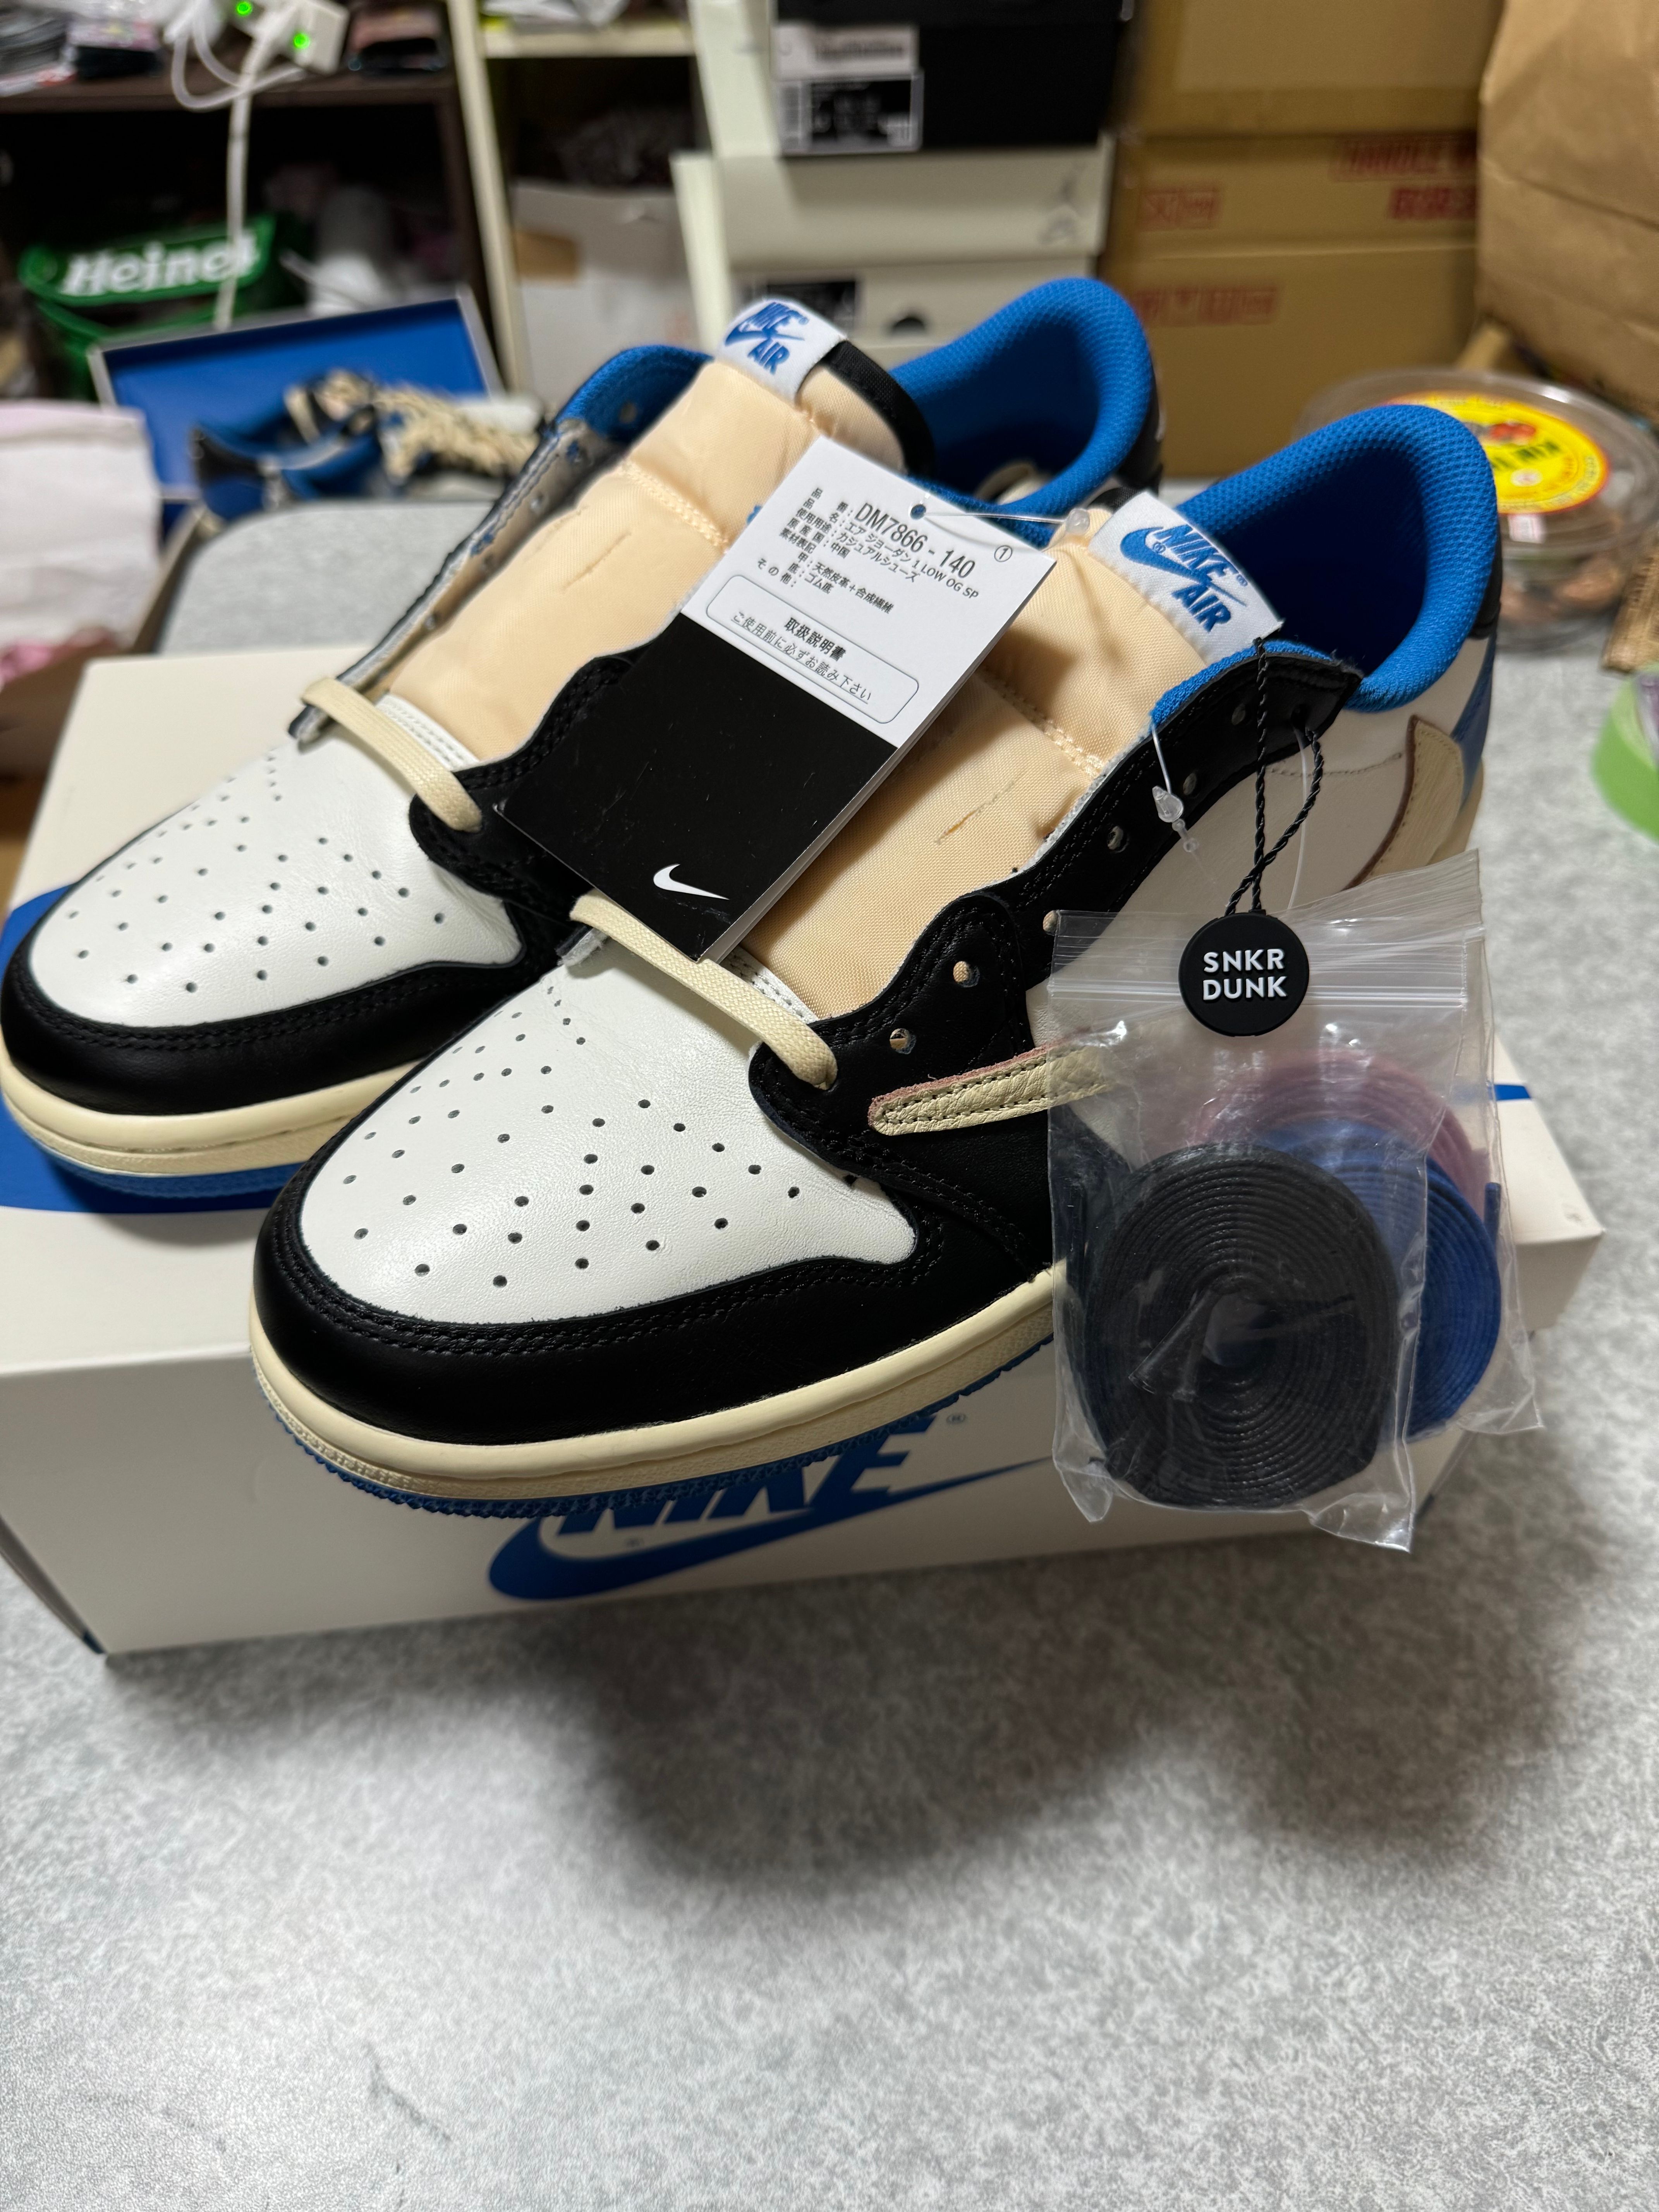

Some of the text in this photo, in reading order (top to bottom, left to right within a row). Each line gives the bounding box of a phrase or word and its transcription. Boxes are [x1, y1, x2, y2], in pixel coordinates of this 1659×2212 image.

[745, 302, 804, 332] NIKE
[747, 338, 790, 375] AIR
[779, 527, 817, 554] 素材表記
[1152, 523, 1239, 582] NIKE
[920, 564, 947, 582] LOW
[946, 578, 964, 592] OG
[962, 587, 979, 599] SP
[1171, 584, 1231, 633] AIR
[733, 611, 871, 701] ご使用前に必ずお読み下さい
[784, 617, 847, 662] 取扱説明書
[1203, 948, 1285, 973] SNKR
[1203, 976, 1288, 1001] DUNK
